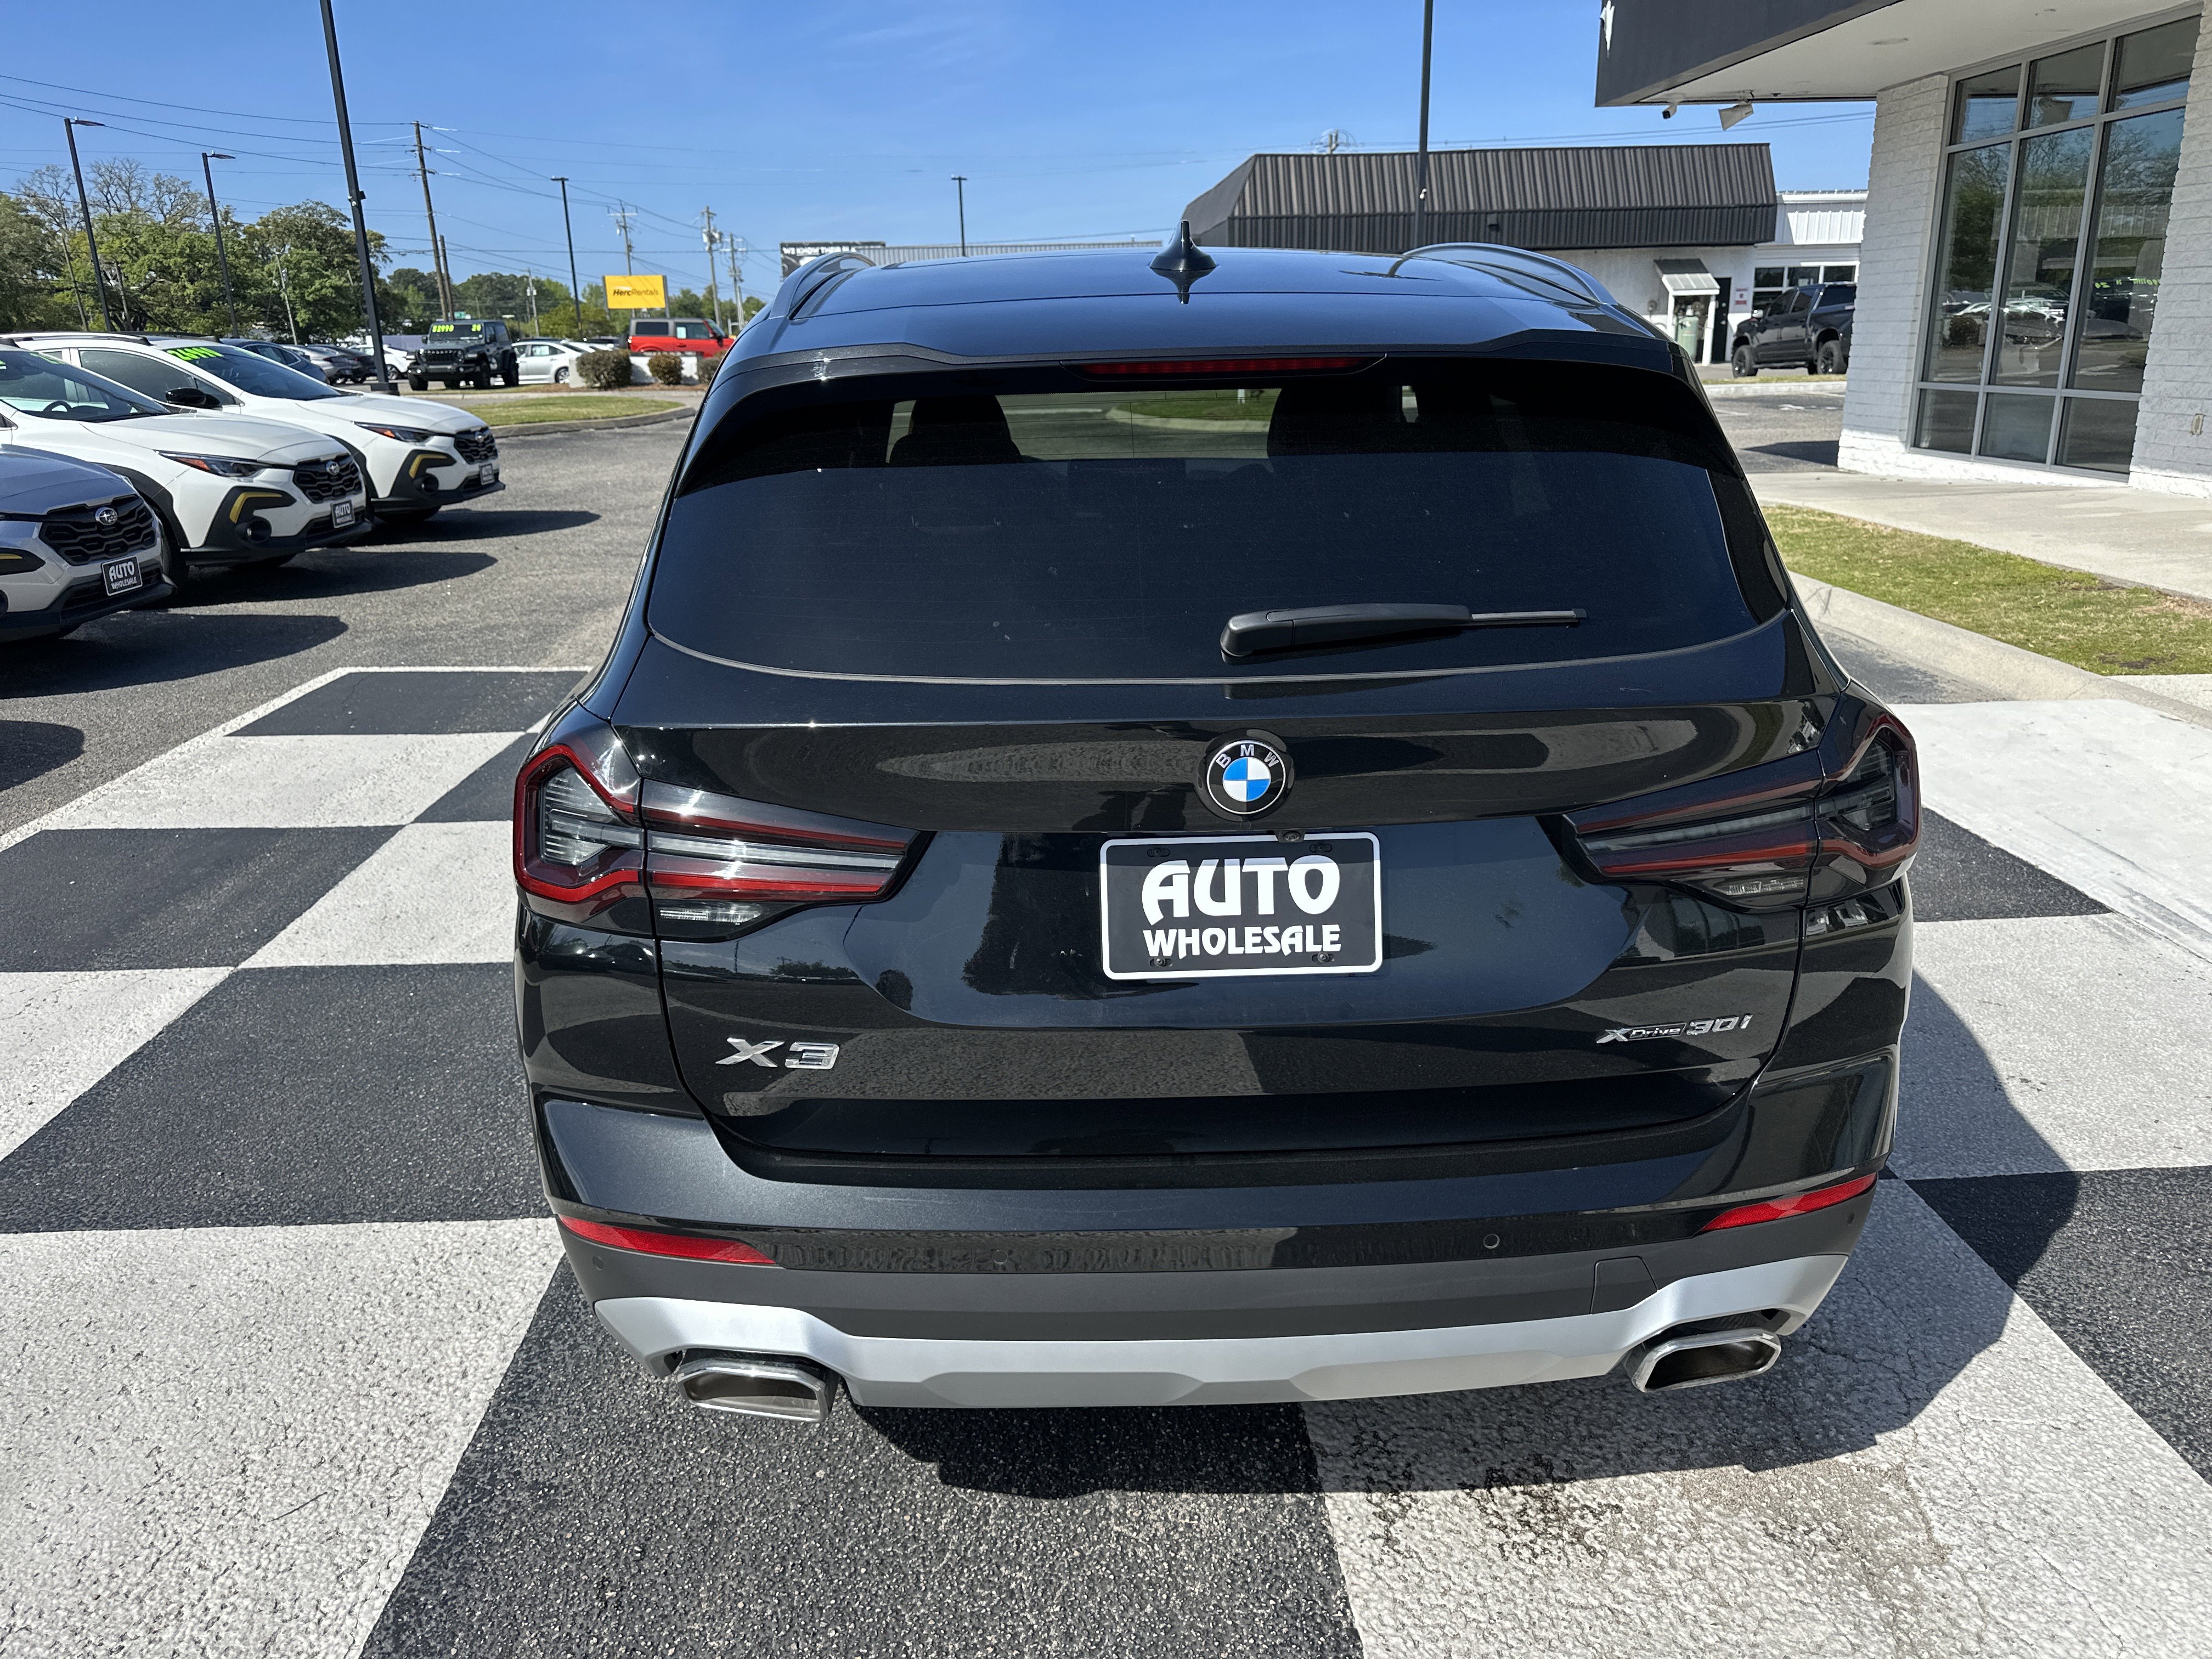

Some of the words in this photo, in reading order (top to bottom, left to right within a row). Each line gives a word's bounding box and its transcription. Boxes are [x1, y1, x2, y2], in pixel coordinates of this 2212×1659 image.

[109, 561, 134, 582] AUTO
[111, 577, 137, 589] WHOLESALE
[1215, 744, 1279, 769] BMW
[1142, 855, 1340, 926] AUTO
[1142, 924, 1341, 960] WHOLESALE
[715, 1037, 840, 1069] X3
